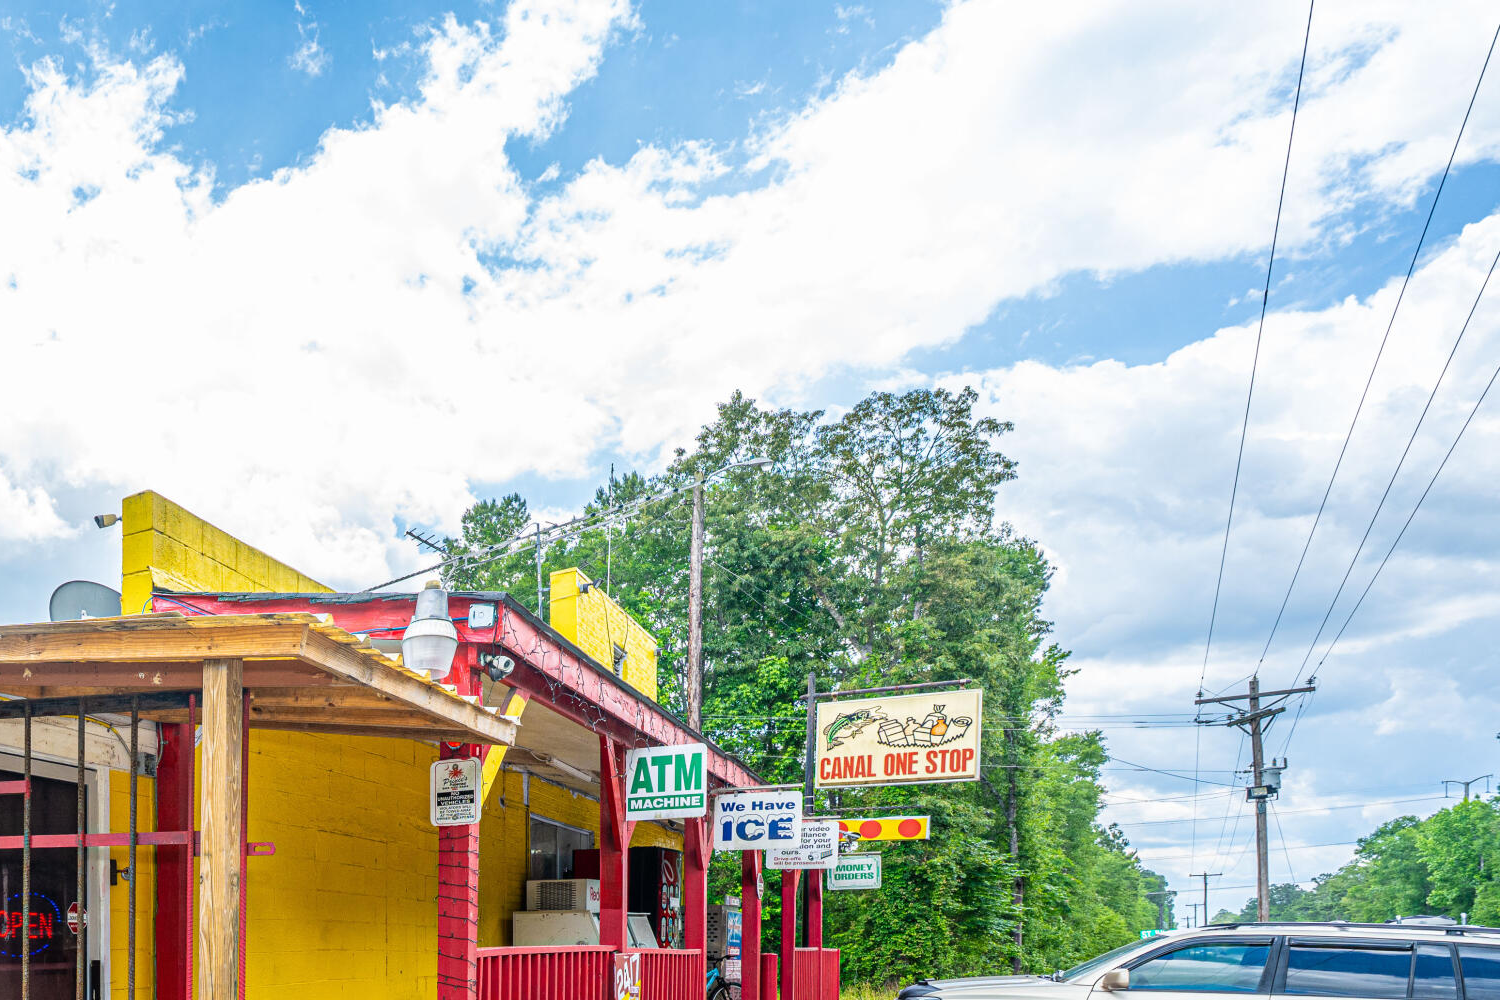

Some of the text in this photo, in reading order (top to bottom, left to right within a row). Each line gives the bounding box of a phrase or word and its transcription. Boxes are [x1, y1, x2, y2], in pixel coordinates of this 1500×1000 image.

[820, 748, 975, 780] CANAL ONE STOP
[630, 752, 703, 795] ATM
[630, 795, 701, 810] MACHINE
[720, 801, 796, 812] We Have
[719, 812, 796, 842] ICE
[835, 863, 873, 872] MONEY
[834, 872, 874, 881] ORDERS
